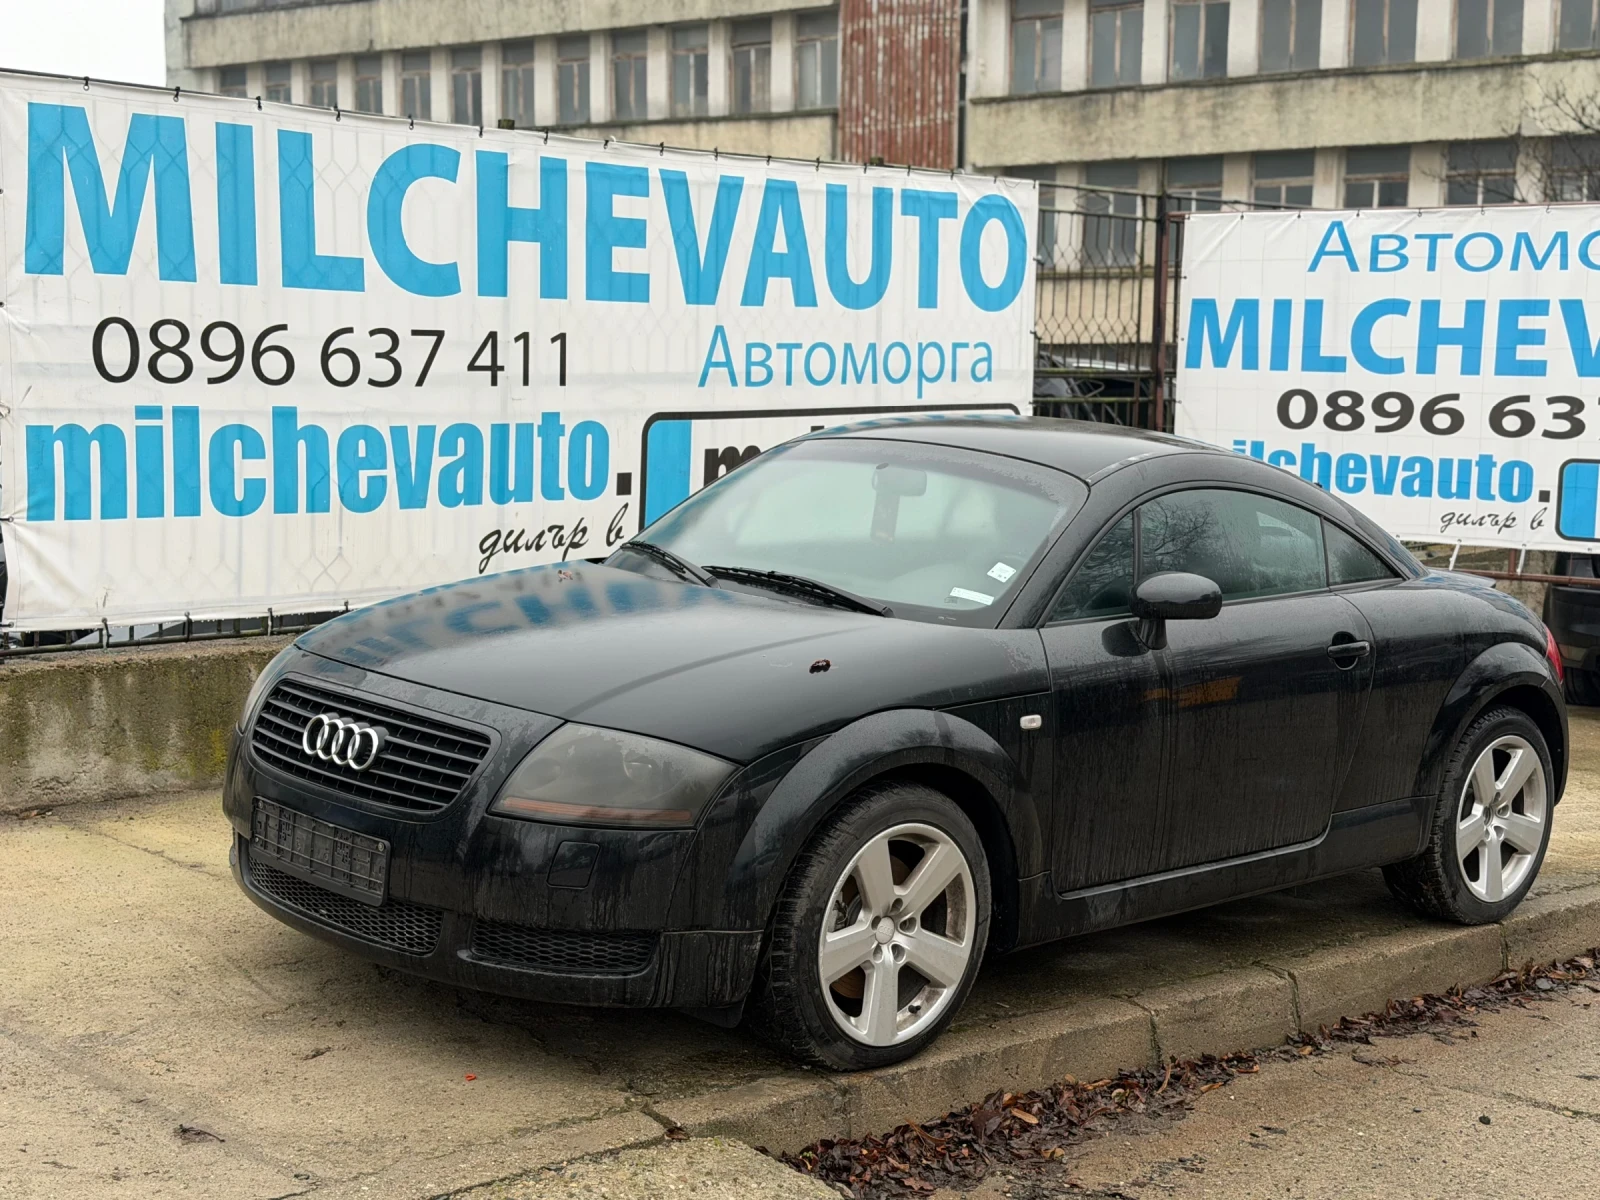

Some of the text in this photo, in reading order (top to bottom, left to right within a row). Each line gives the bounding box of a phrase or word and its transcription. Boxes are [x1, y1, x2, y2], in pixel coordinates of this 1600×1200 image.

[24, 101, 1027, 312] MILCHEVAUTO
[92, 316, 567, 388] 0896 637 411
[698, 324, 993, 399] Автоморга
[1276, 388, 1600, 440] 0896 63
[478, 501, 630, 575] дилър в
[1440, 506, 1548, 534] дилър в
